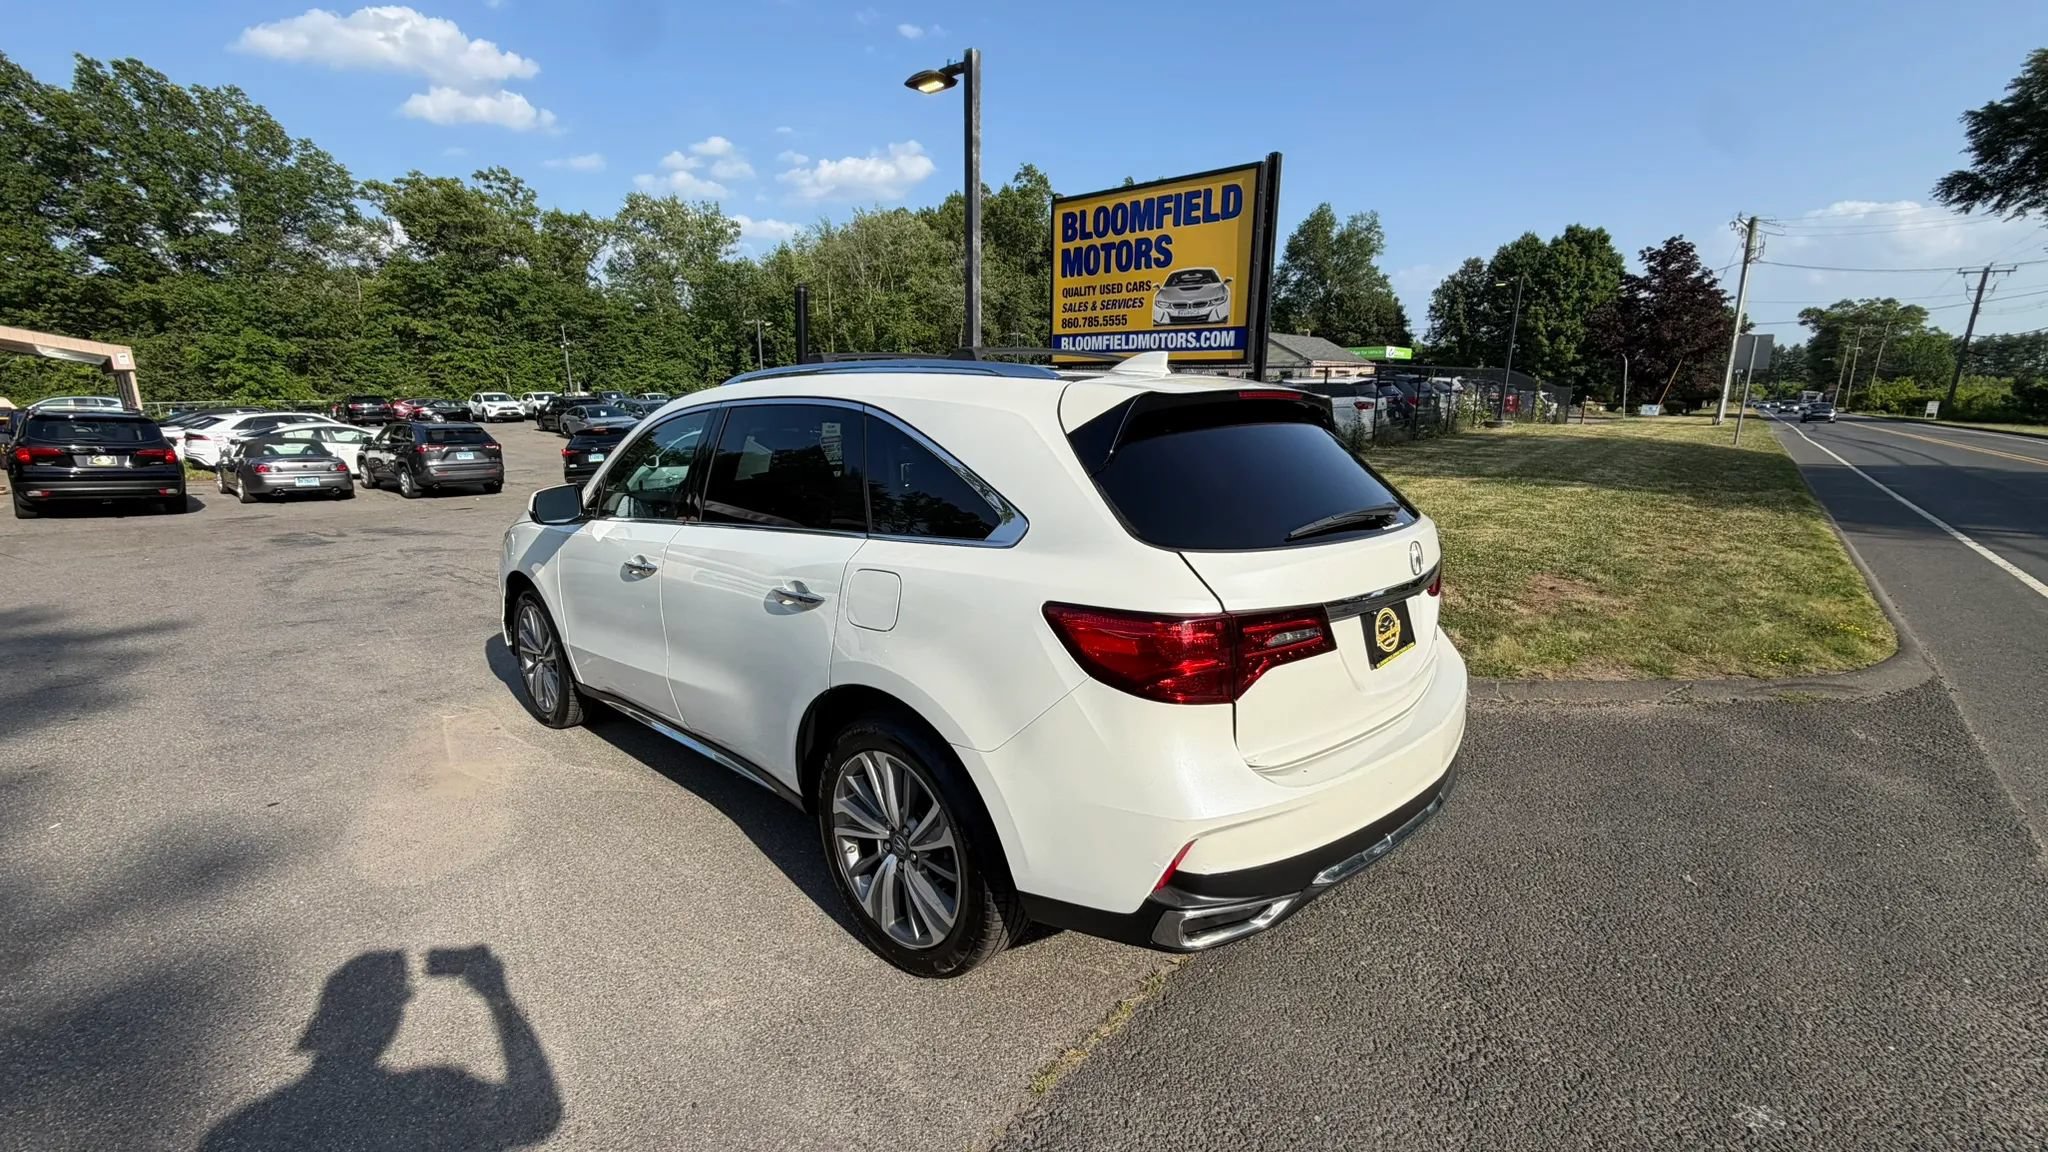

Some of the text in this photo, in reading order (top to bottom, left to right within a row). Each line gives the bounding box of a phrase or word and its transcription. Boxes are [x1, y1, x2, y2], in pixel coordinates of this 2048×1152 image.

[1062, 184, 1242, 243] BLOOMFIELD
[1061, 234, 1173, 278] MOTORS
[1062, 280, 1152, 298] QUALITY USED CARS
[1062, 297, 1145, 313] SALES & SERVICES
[1061, 314, 1128, 329] 860.785.5555
[1061, 330, 1235, 350] BLOOMFIELDMOTORS.COM
